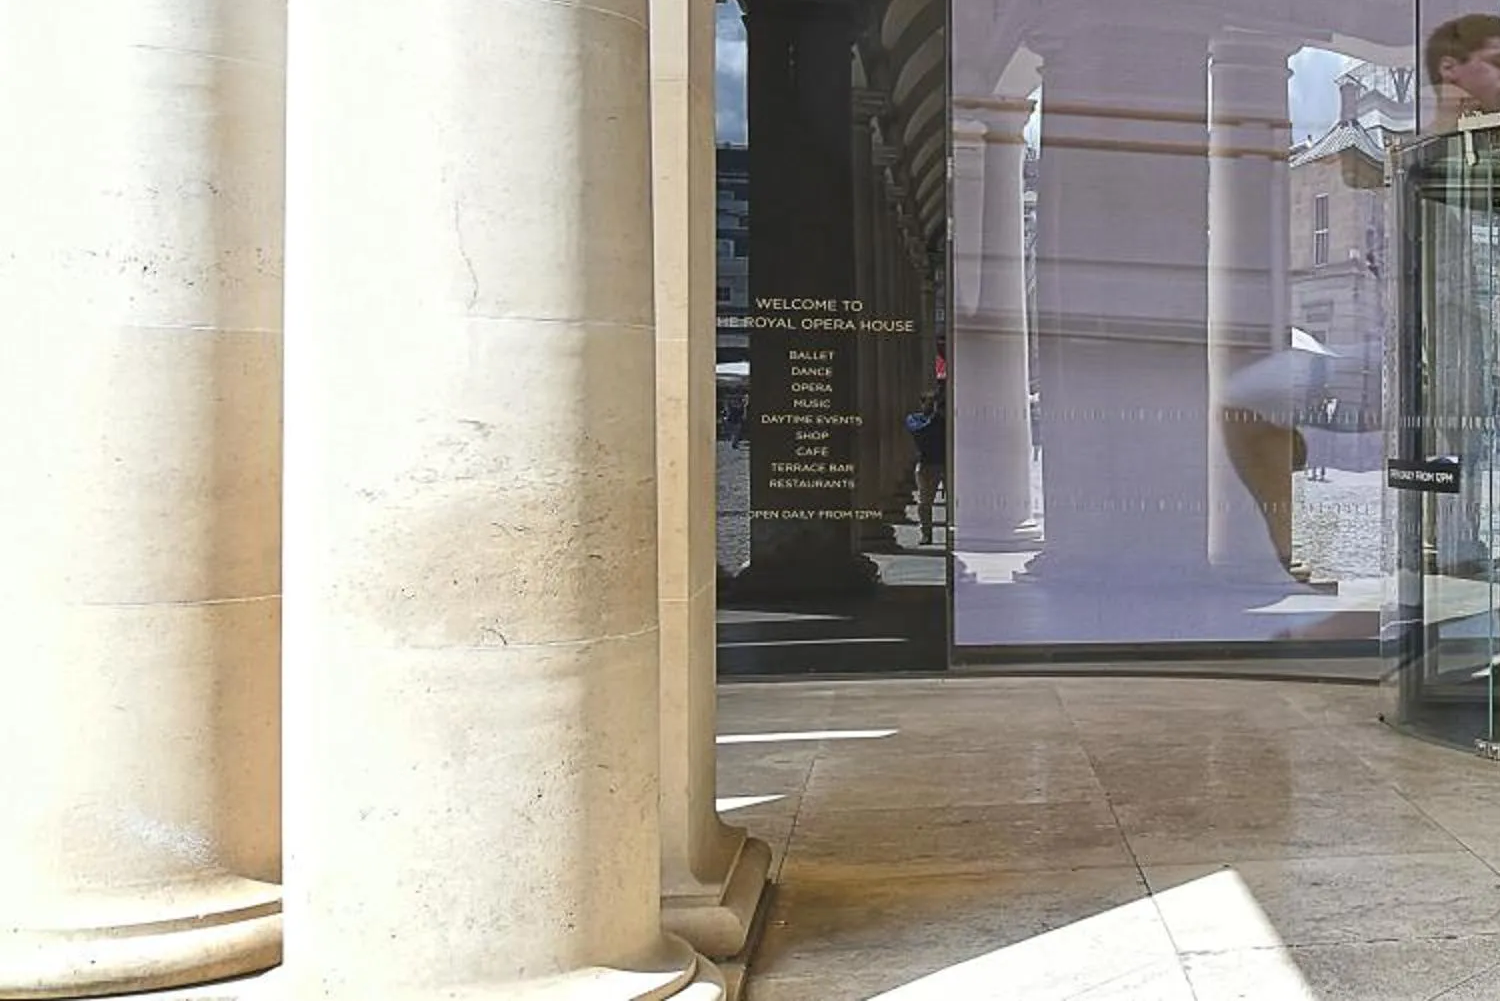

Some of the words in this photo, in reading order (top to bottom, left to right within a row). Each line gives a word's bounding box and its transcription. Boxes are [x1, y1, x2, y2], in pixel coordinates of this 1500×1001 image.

[755, 298, 837, 311] WELCOME
[843, 300, 863, 312] TO
[717, 316, 741, 328] HE
[743, 316, 796, 329] ROYAL
[801, 318, 855, 330] OPERA
[860, 320, 914, 332] HOUSE
[789, 350, 834, 360] BALLET
[791, 366, 833, 376] DANCE
[791, 382, 833, 392] OPERA
[793, 399, 831, 408] MUSIC
[761, 414, 813, 424] DAYTIME
[816, 414, 863, 426] EVENTS
[796, 430, 829, 439] SHOP
[771, 462, 825, 472] TERRACE
[829, 463, 854, 472] BAR
[769, 478, 855, 489] RESTAURANTS
[748, 510, 779, 519] OPEN
[782, 510, 815, 519] DAILY
[819, 510, 852, 519] FROM
[855, 510, 883, 519] 12PM
